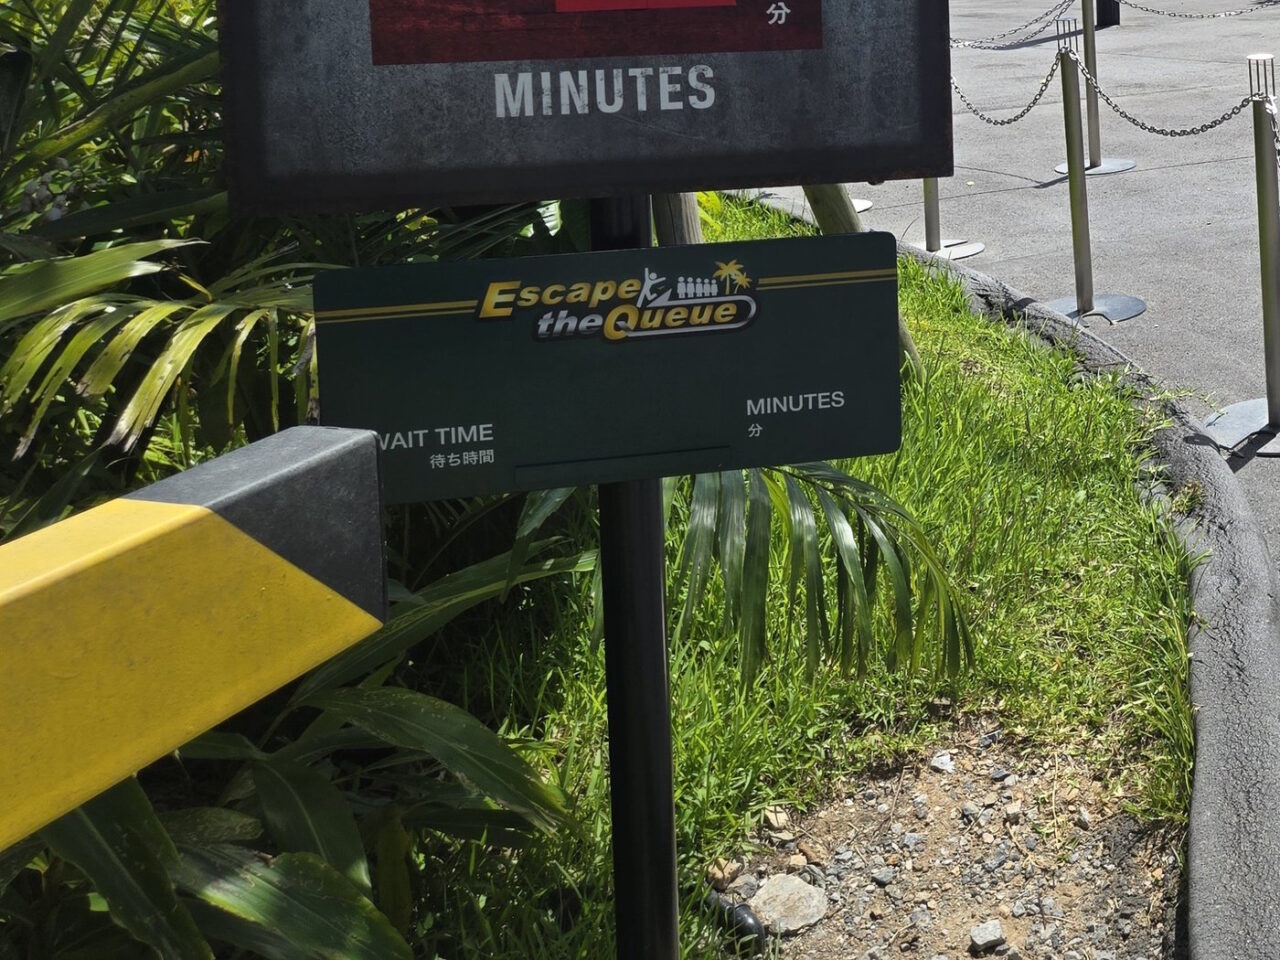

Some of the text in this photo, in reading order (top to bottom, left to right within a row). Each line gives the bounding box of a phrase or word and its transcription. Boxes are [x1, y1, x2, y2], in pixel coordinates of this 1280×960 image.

[766, 2, 791, 25] 分
[494, 64, 716, 118] MINUTES
[479, 276, 641, 319] Escape
[537, 302, 738, 340] the Queue
[746, 391, 846, 417] MINUTES
[434, 423, 494, 445] TIME
[748, 424, 763, 438] 分
[430, 449, 495, 469] 待ち時間
